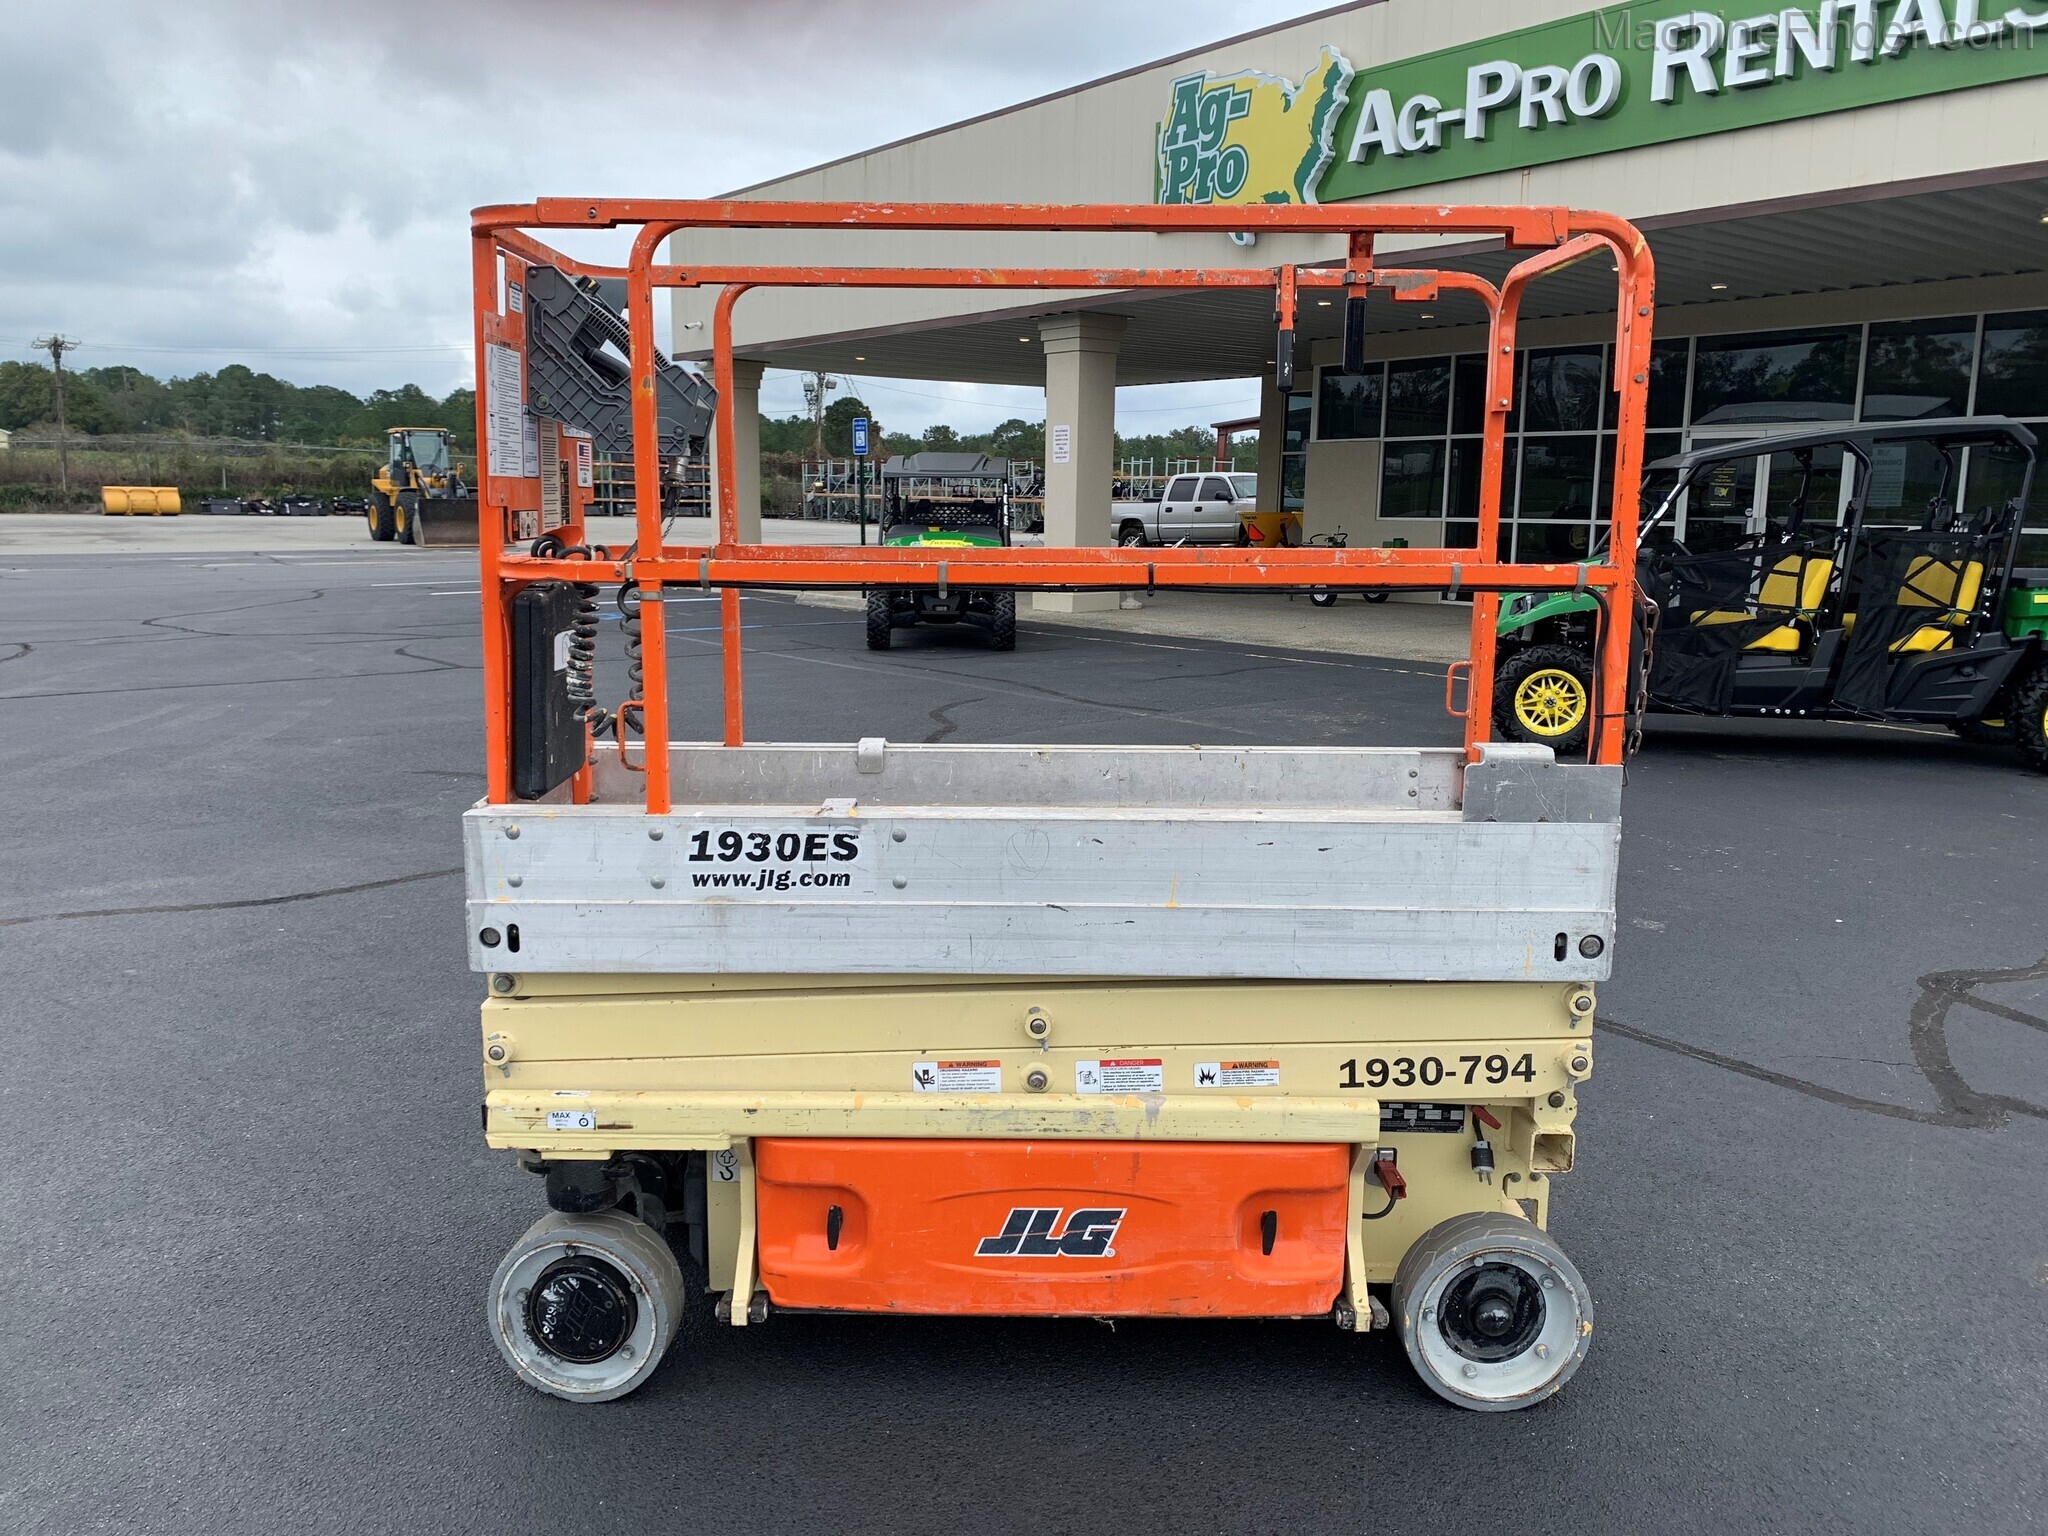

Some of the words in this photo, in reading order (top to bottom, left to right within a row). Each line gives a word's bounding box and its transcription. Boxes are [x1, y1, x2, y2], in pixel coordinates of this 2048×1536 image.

[1160, 143, 1249, 204] Pro
[1871, 458, 1903, 466] ARNING
[688, 829, 859, 863] 1930ES
[691, 869, 851, 891] www.jlg.com
[1238, 1061, 1268, 1069] WARNING
[1338, 1052, 1537, 1089] 1930-794
[973, 1207, 1128, 1257] JLG
